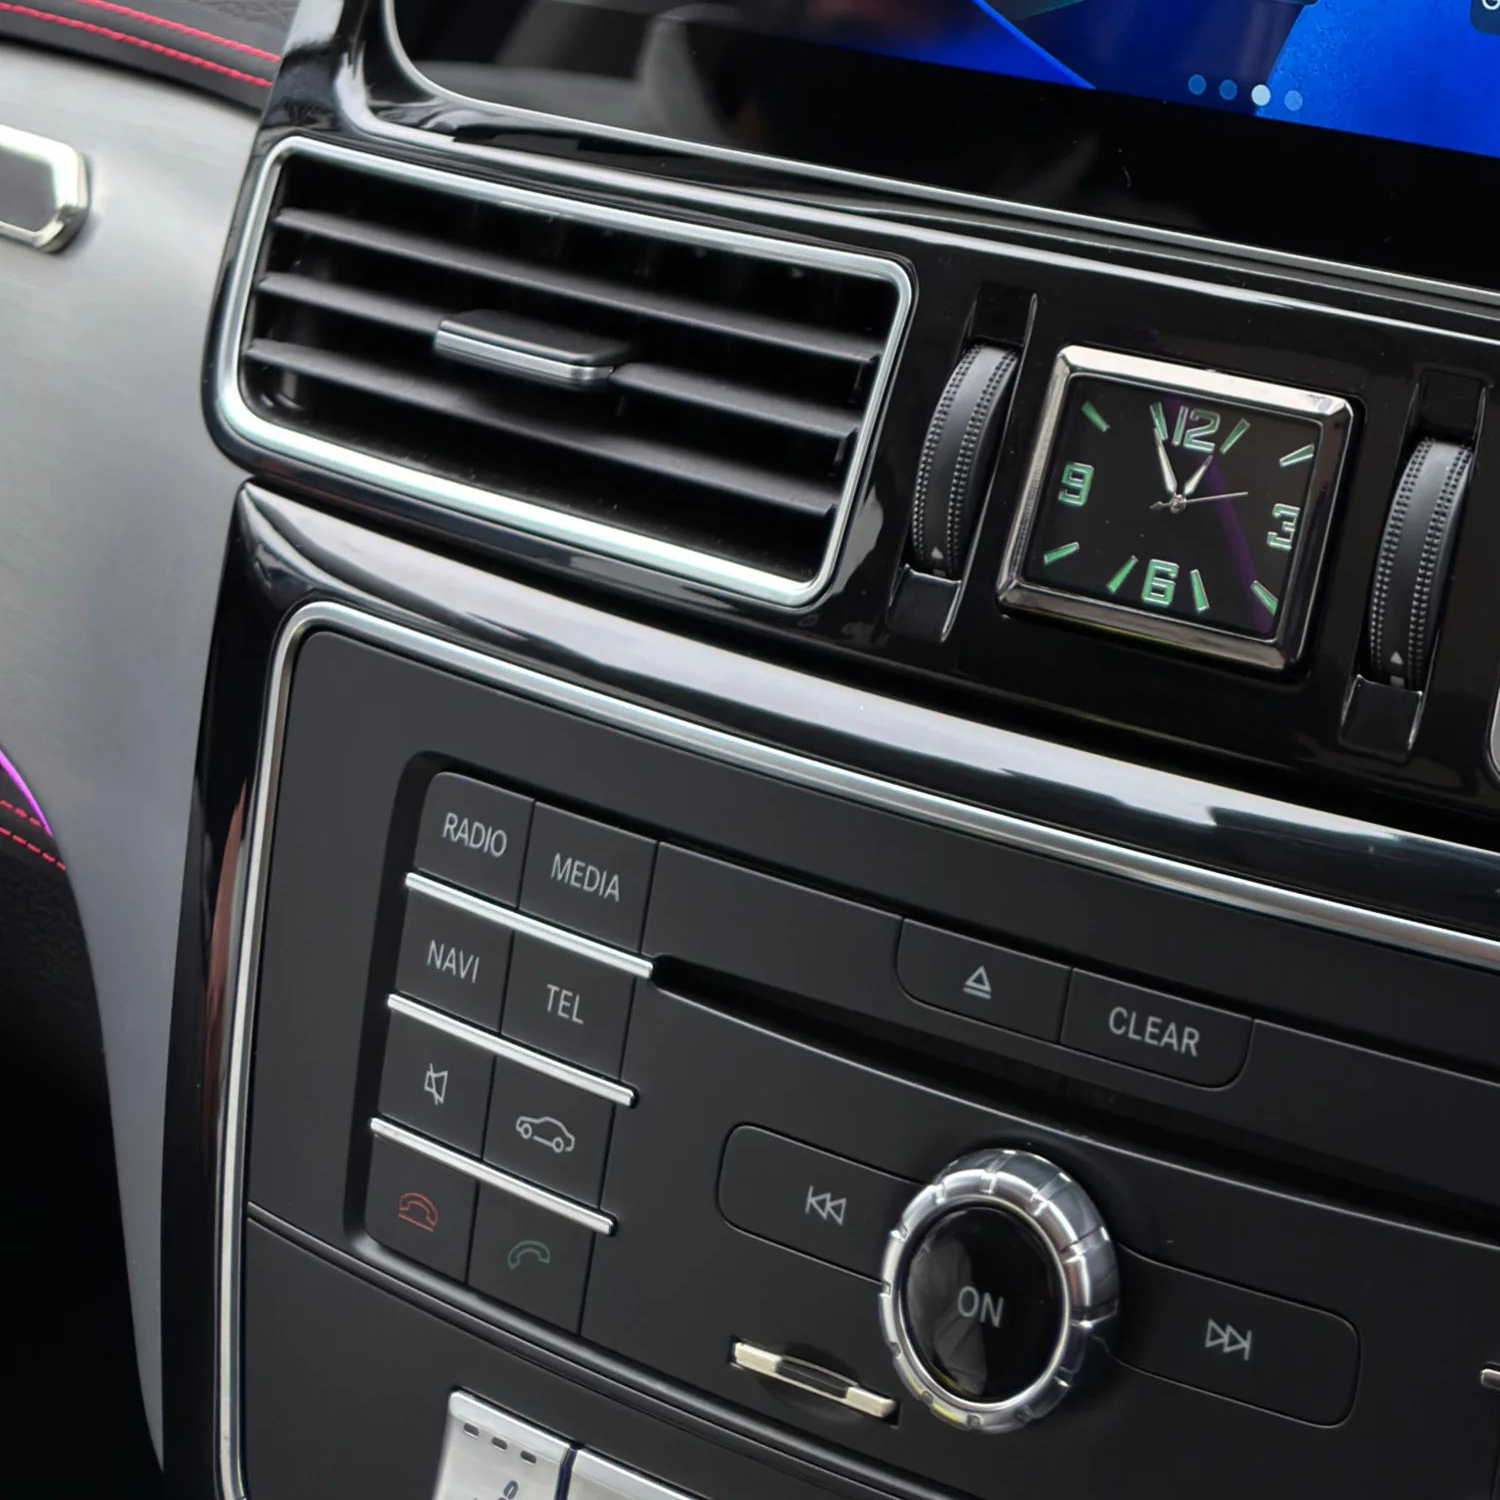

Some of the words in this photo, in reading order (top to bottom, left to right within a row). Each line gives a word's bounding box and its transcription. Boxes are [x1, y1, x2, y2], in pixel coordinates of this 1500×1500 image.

[1172, 406, 1220, 453] 12
[1058, 463, 1094, 506] 9
[1267, 503, 1301, 550] 3
[1142, 559, 1179, 607] 6
[442, 812, 508, 859] RADIO
[550, 852, 621, 903] MEDIA
[426, 938, 480, 984] NAVI
[546, 982, 585, 1026] TEL
[1108, 1005, 1200, 1058] CLEAR
[955, 1284, 1006, 1328] ON
